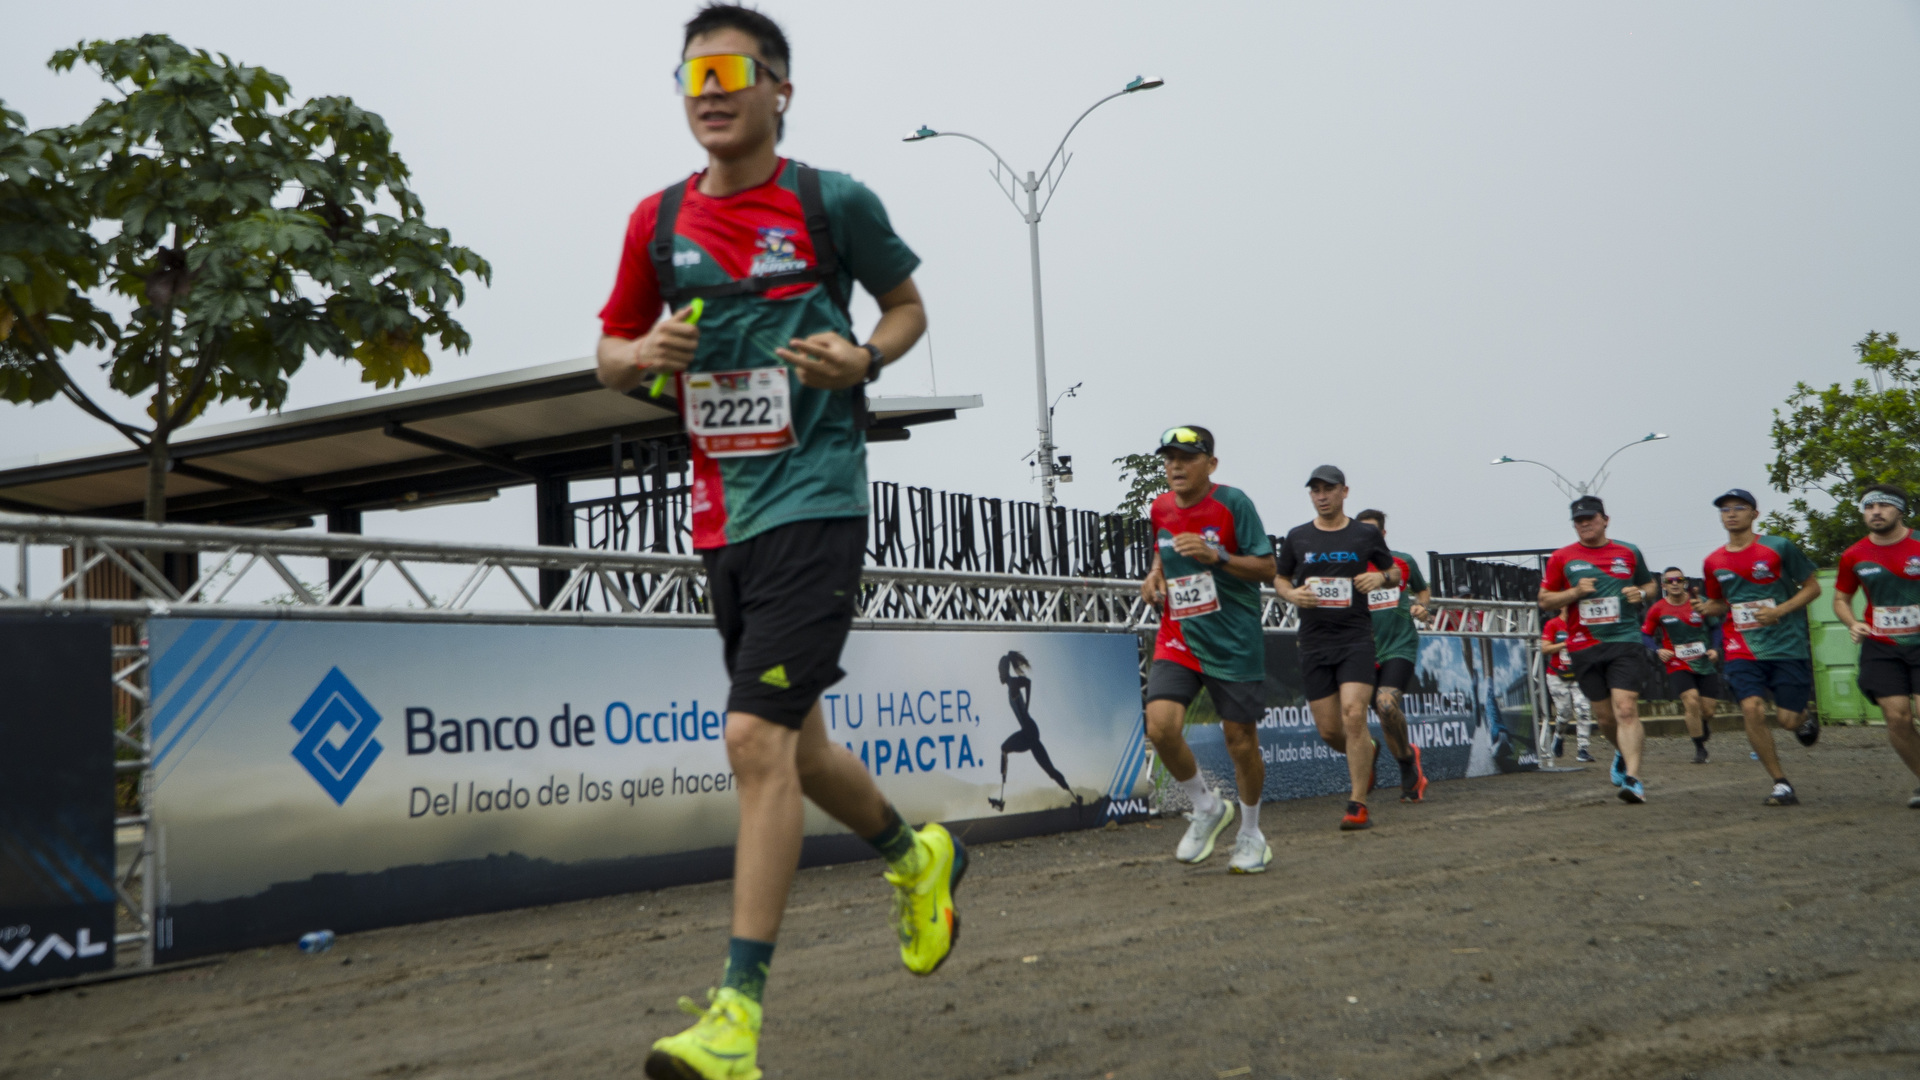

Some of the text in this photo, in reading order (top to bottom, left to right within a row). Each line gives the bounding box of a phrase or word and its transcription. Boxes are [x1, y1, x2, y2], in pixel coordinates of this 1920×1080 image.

[701, 397, 773, 429] 2222
[1305, 551, 1360, 563] KAPPA
[1174, 588, 1202, 606] 942
[1316, 587, 1339, 598] 388
[1370, 591, 1390, 603] 503
[1587, 605, 1609, 616] 191
[1882, 614, 1910, 626] 314
[825, 690, 981, 730] TU HACER,
[1402, 693, 1421, 717] TU
[1422, 691, 1470, 717] HACER,
[405, 700, 727, 756] Banco de Occide
[1407, 721, 1473, 748] IMPACTA.
[1299, 741, 1312, 760] de
[1313, 740, 1328, 759] los
[409, 782, 458, 819] Del
[467, 778, 531, 813] lado
[537, 775, 571, 806] de
[578, 773, 613, 803] los
[621, 776, 665, 807] que
[1106, 798, 1148, 817] AVAL
[0, 928, 108, 972] VAL
